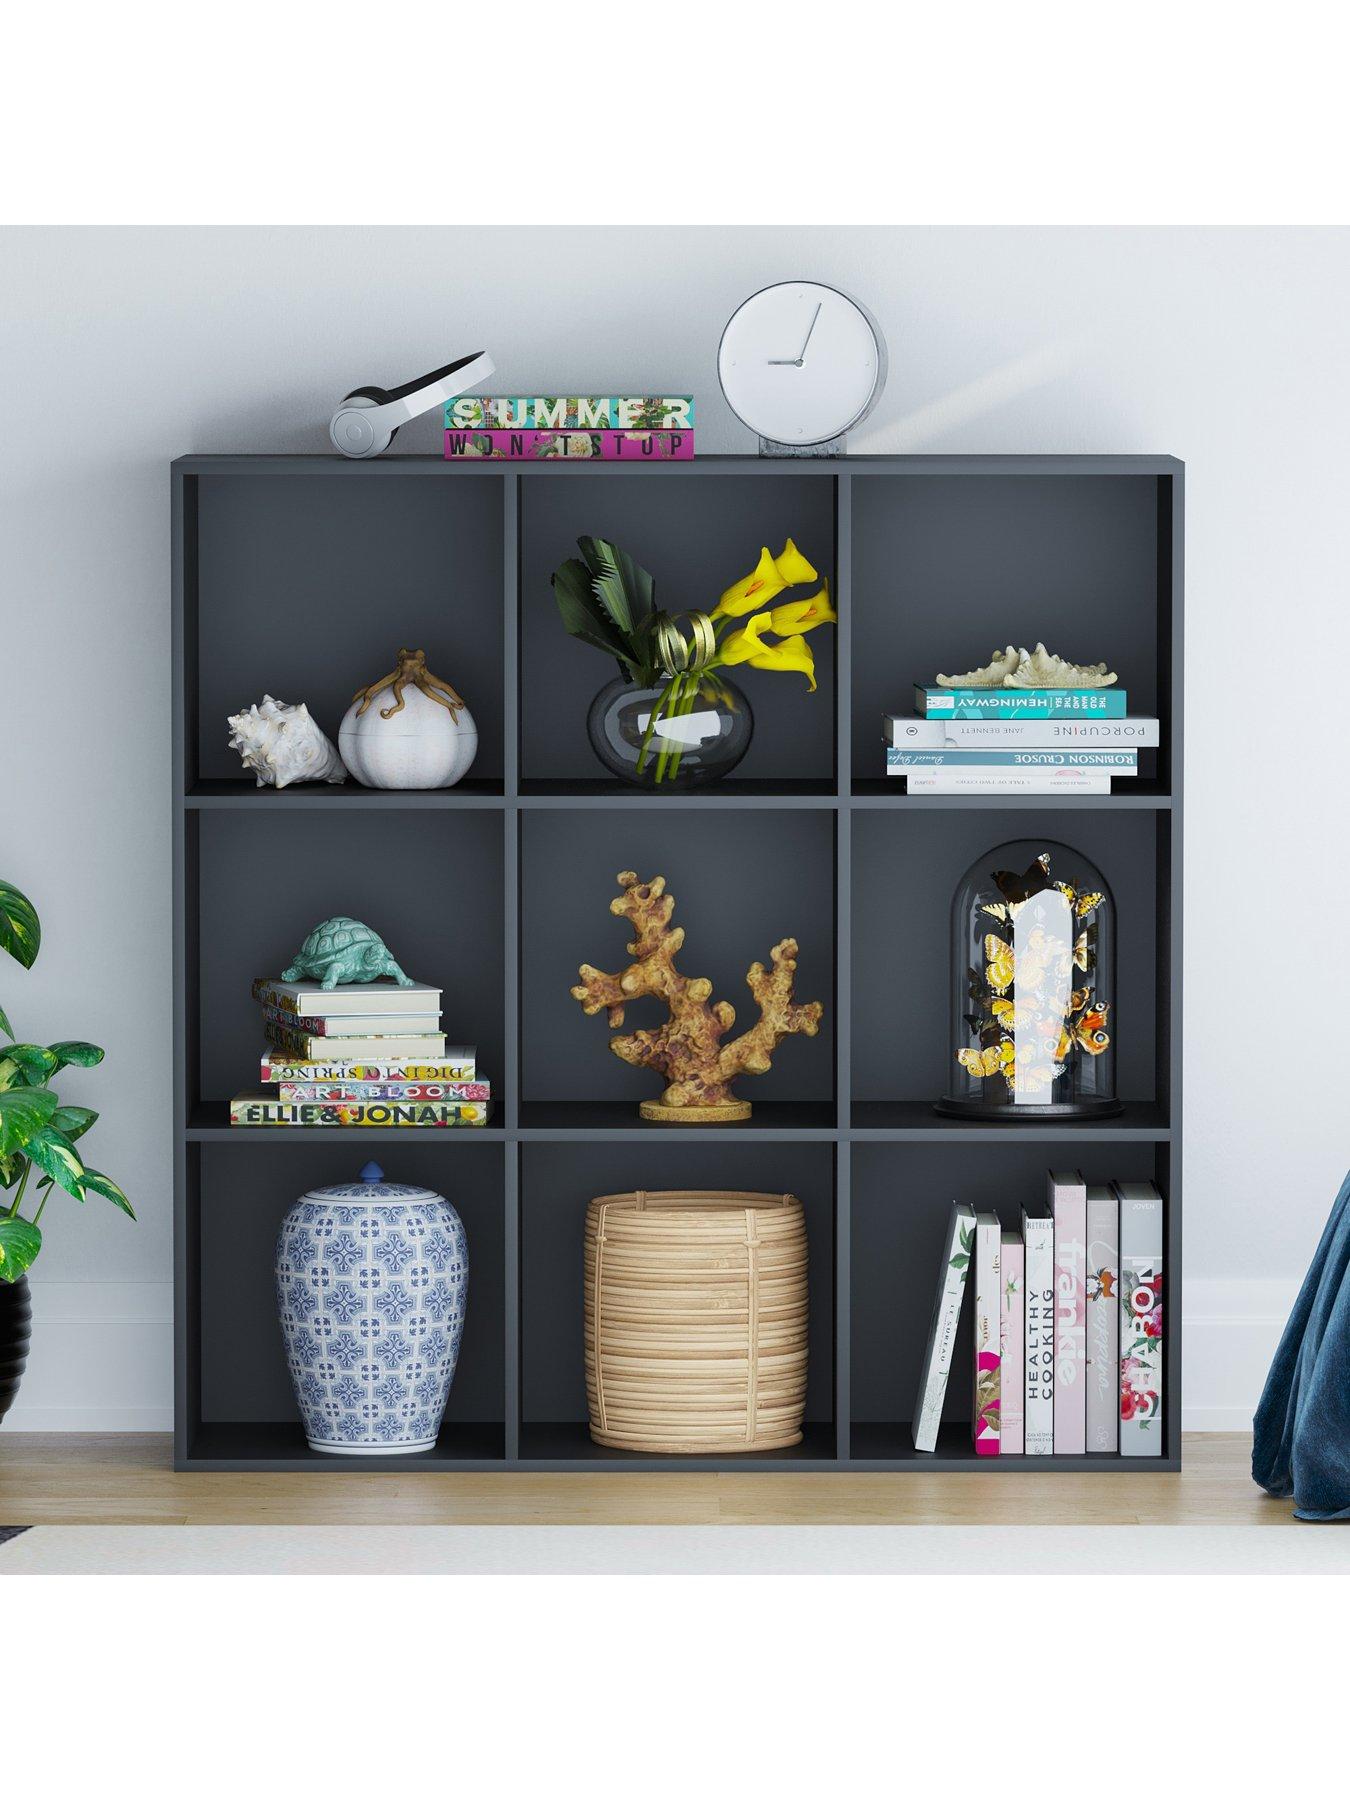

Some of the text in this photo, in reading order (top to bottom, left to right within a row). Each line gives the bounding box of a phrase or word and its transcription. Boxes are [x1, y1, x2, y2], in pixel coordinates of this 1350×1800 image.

[453, 398, 692, 428] SUMMER
[591, 433, 682, 456] STOP
[958, 698, 1047, 707] HEMINGWAY
[1072, 695, 1080, 709] AND
[1053, 726, 1145, 736] PORCUPINE
[288, 1016, 320, 1033] BLOOM
[283, 1067, 357, 1079] SPRING
[427, 1067, 463, 1079] DIG
[292, 1086, 468, 1098] ART BLOOM
[247, 1105, 314, 1122] ELLIE
[351, 1105, 462, 1123] JONAH
[1057, 1237, 1086, 1386] frankie
[1028, 1290, 1039, 1399] HEALTHY
[1042, 1289, 1054, 1400] COOKING
